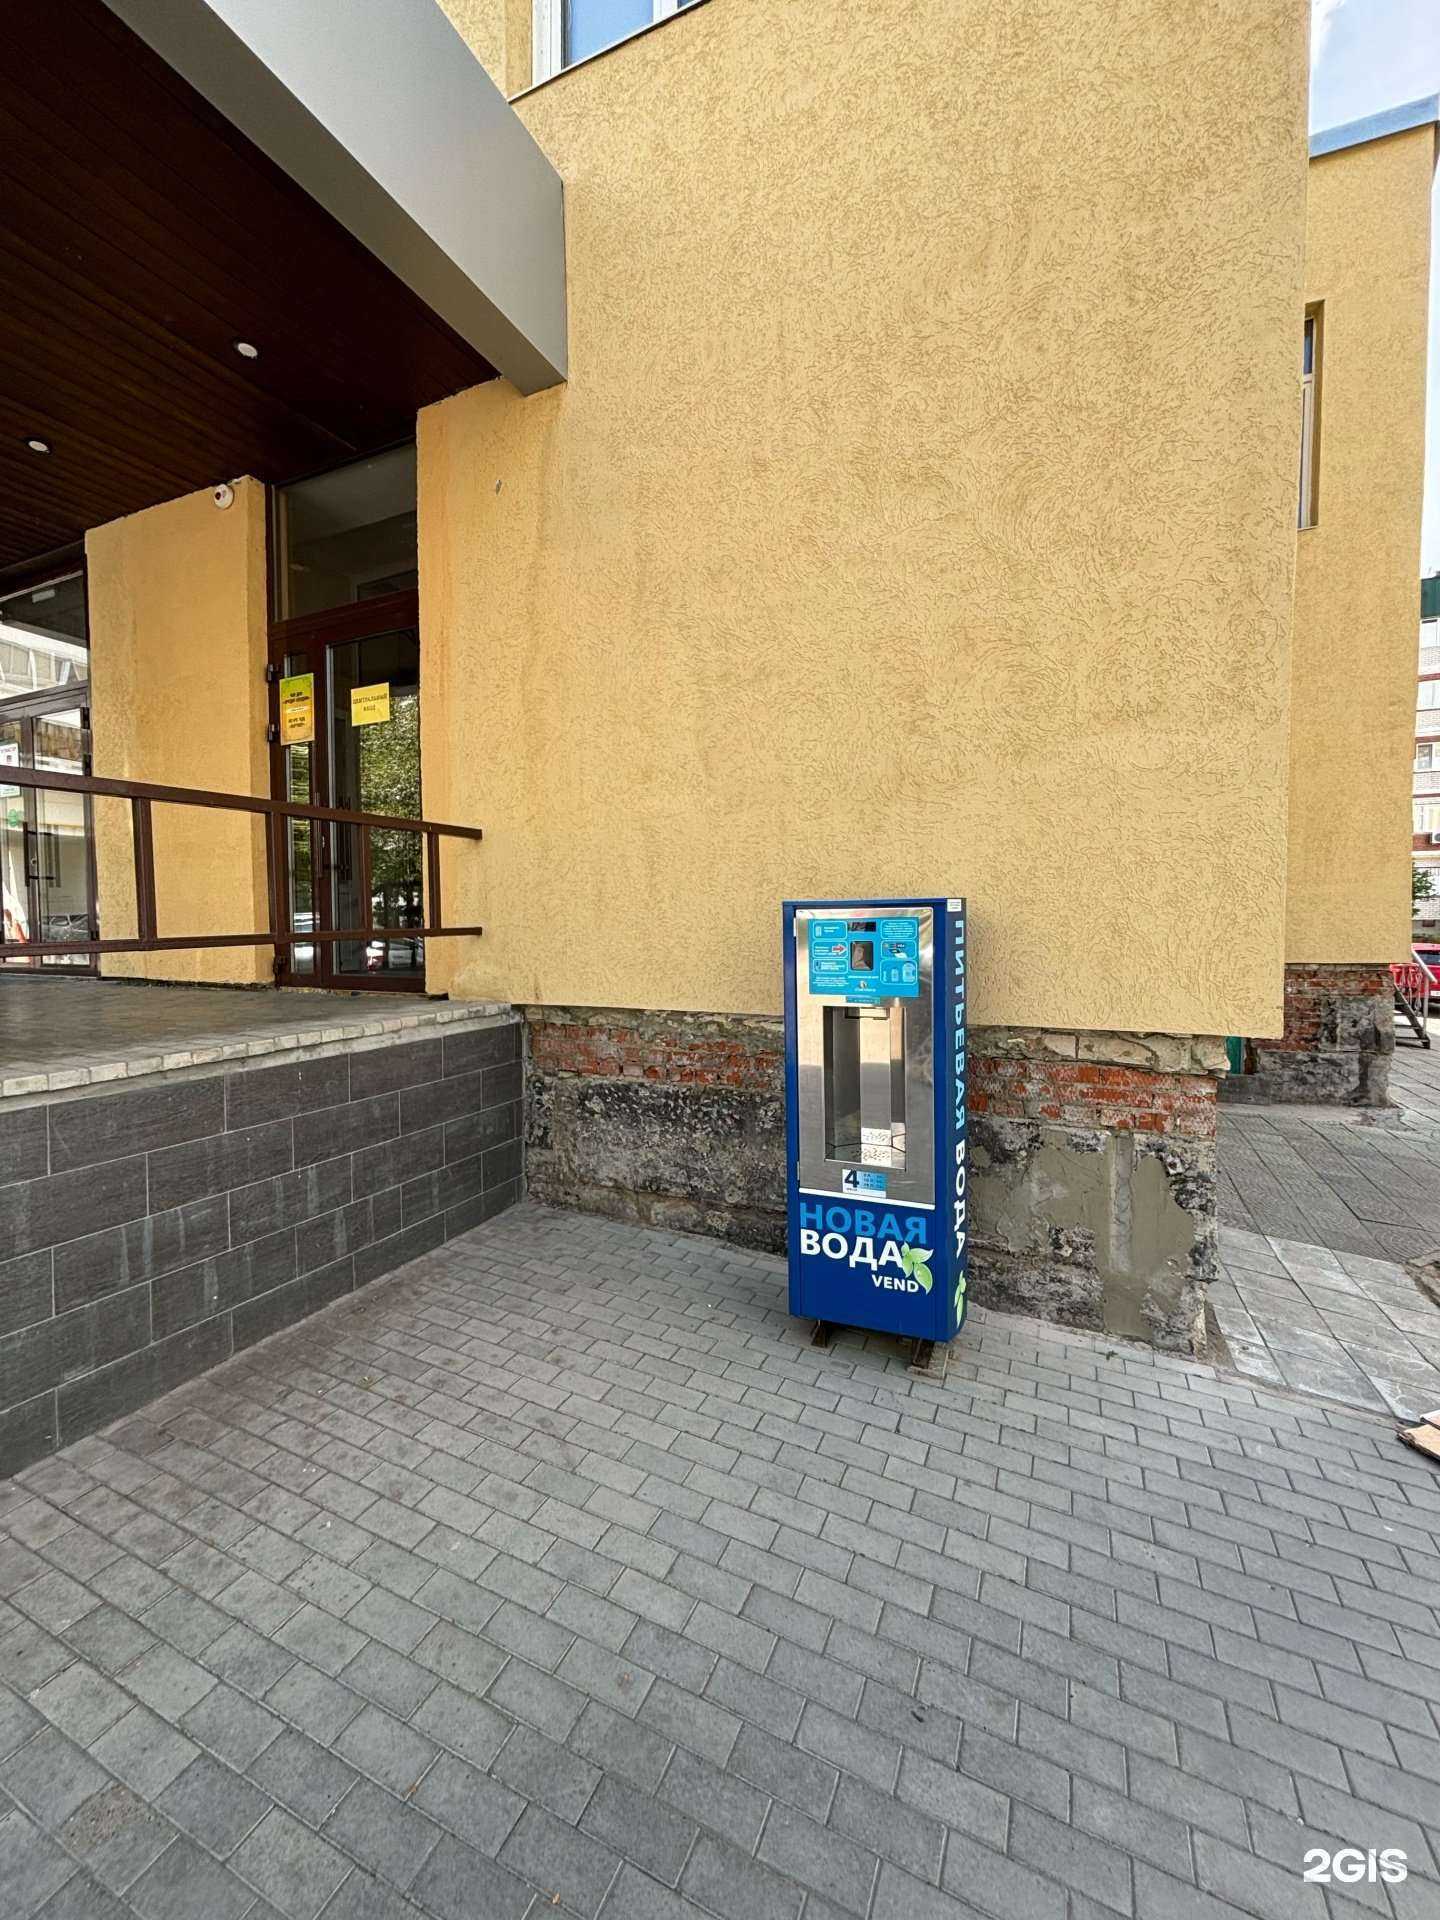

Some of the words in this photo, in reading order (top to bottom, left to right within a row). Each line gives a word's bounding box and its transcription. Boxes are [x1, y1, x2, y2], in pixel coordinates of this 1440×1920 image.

[955, 920, 966, 1130] ПИТЬЕВАЯ
[844, 1170, 860, 1188] 4
[954, 1140, 966, 1259] ВОДА
[800, 1202, 927, 1244] НОВАЯ
[800, 1228, 904, 1271] ВОДА
[871, 1274, 919, 1293] VEND
